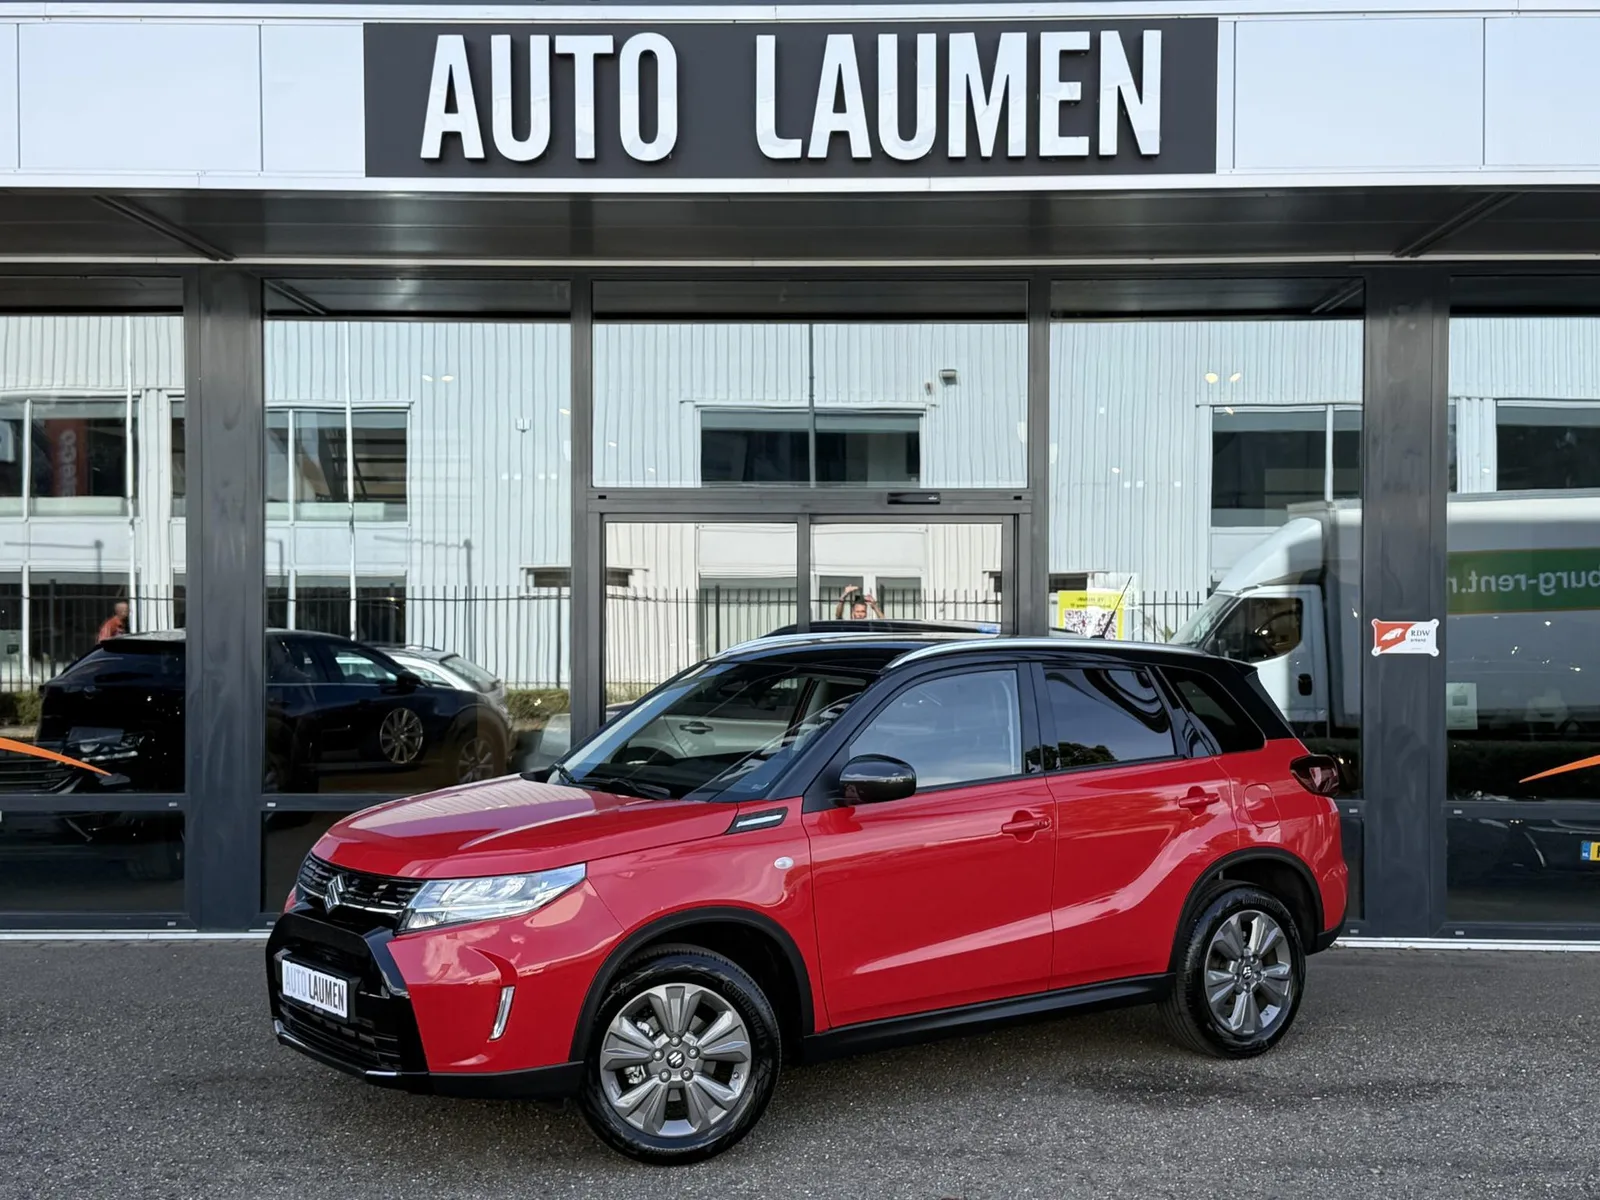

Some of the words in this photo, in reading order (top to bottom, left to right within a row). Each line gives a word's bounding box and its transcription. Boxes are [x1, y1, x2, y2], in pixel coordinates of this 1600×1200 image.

[420, 32, 678, 162] AUTO
[755, 30, 1162, 160] LAUMEN
[1410, 629, 1431, 637] RDW
[285, 966, 307, 997] AUTO
[308, 973, 344, 1012] LAUMEN
